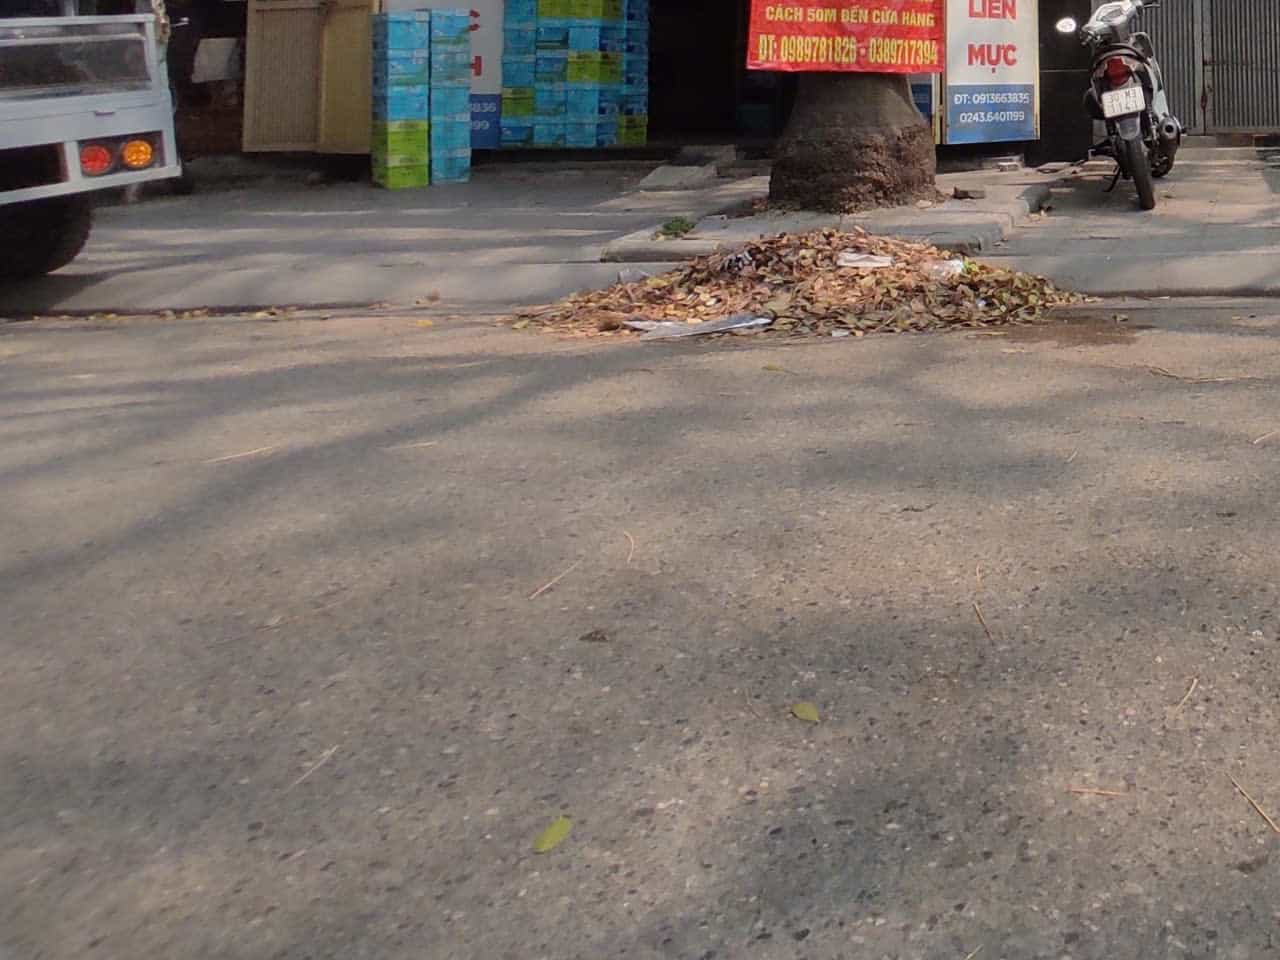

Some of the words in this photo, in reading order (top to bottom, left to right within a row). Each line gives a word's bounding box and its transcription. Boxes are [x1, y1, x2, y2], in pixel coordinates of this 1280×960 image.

[765, 4, 803, 22] CÁCH
[807, 7, 837, 23] 50M
[840, 2, 868, 23] ĐẾN
[872, 6, 898, 25] CỬA
[902, 8, 935, 27] HÀNG
[758, 34, 777, 61] ĐT:
[967, 43, 1018, 74] MỰC
[954, 93, 972, 106] ĐT:
